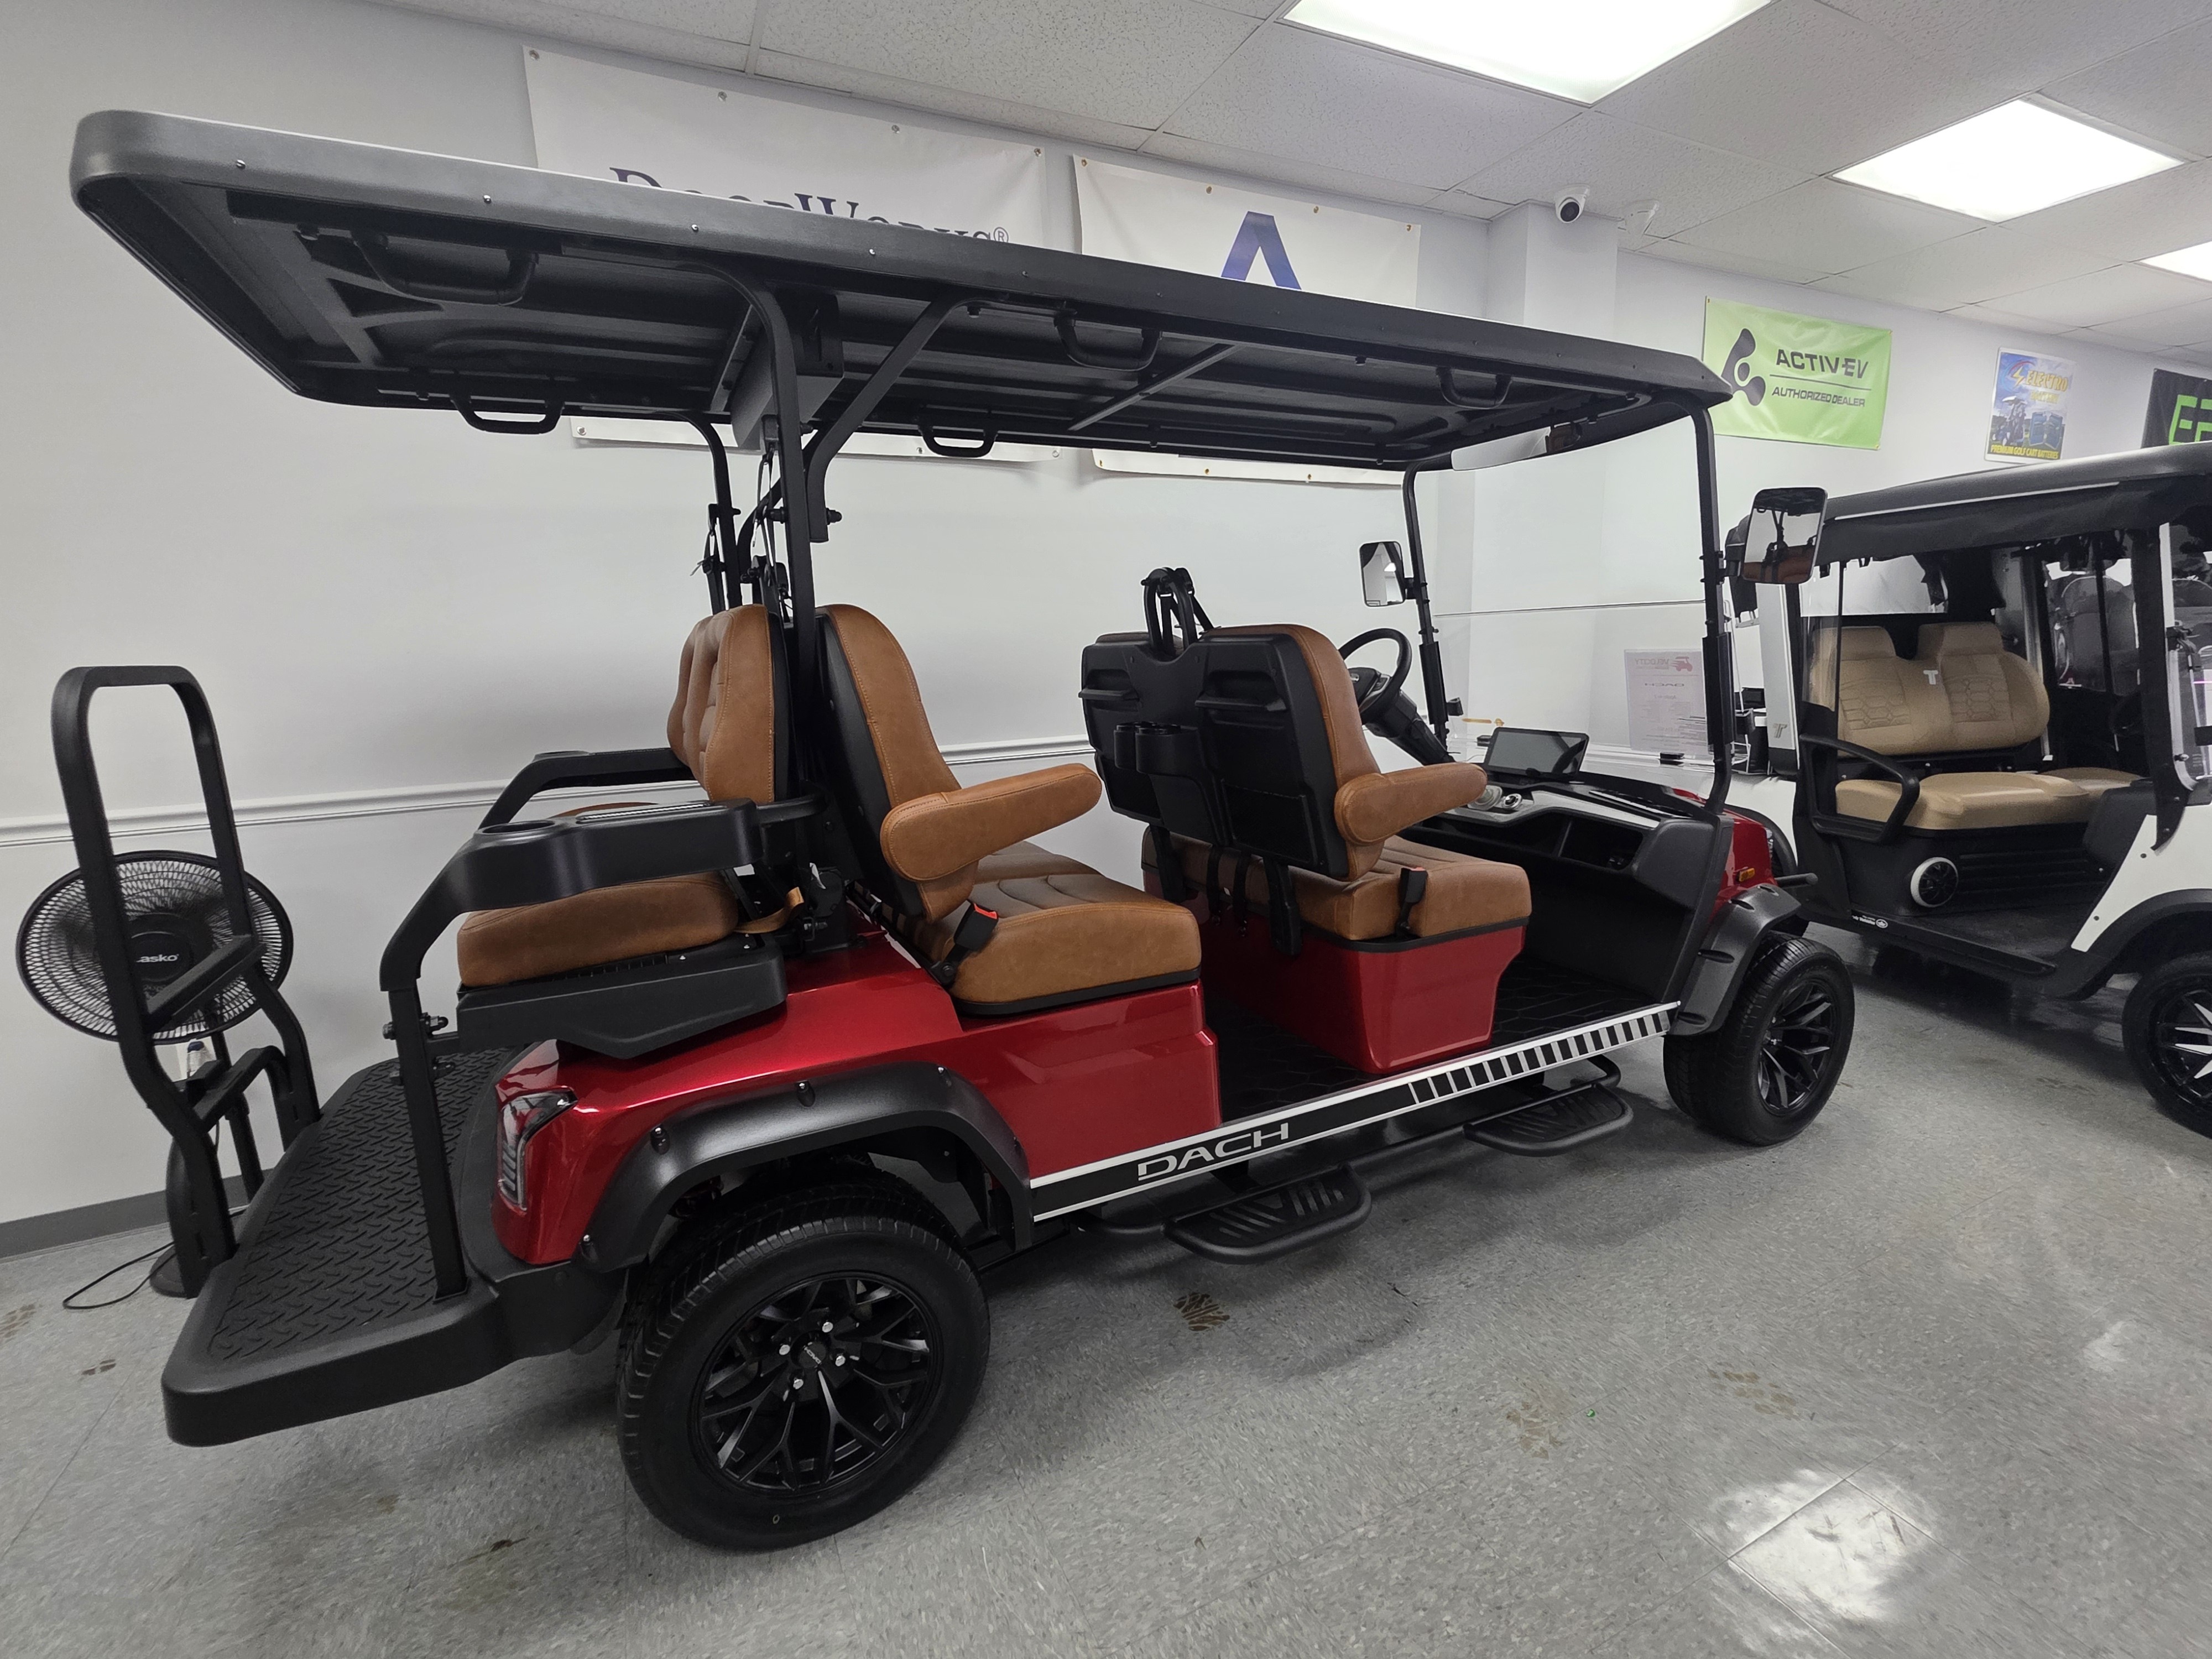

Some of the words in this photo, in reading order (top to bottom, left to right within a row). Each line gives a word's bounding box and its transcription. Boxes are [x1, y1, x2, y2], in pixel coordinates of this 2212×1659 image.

[2026, 370, 2068, 392] ELECTRO
[1772, 387, 1832, 403] AUTHORIZED
[1832, 395, 1865, 407] DEALER
[1991, 444, 2014, 455] PREMIUM
[2013, 447, 2026, 456] GOLF
[2026, 448, 2038, 457] CART
[2038, 450, 2059, 460] BATTERIES
[1137, 1122, 1289, 1182] DACH
